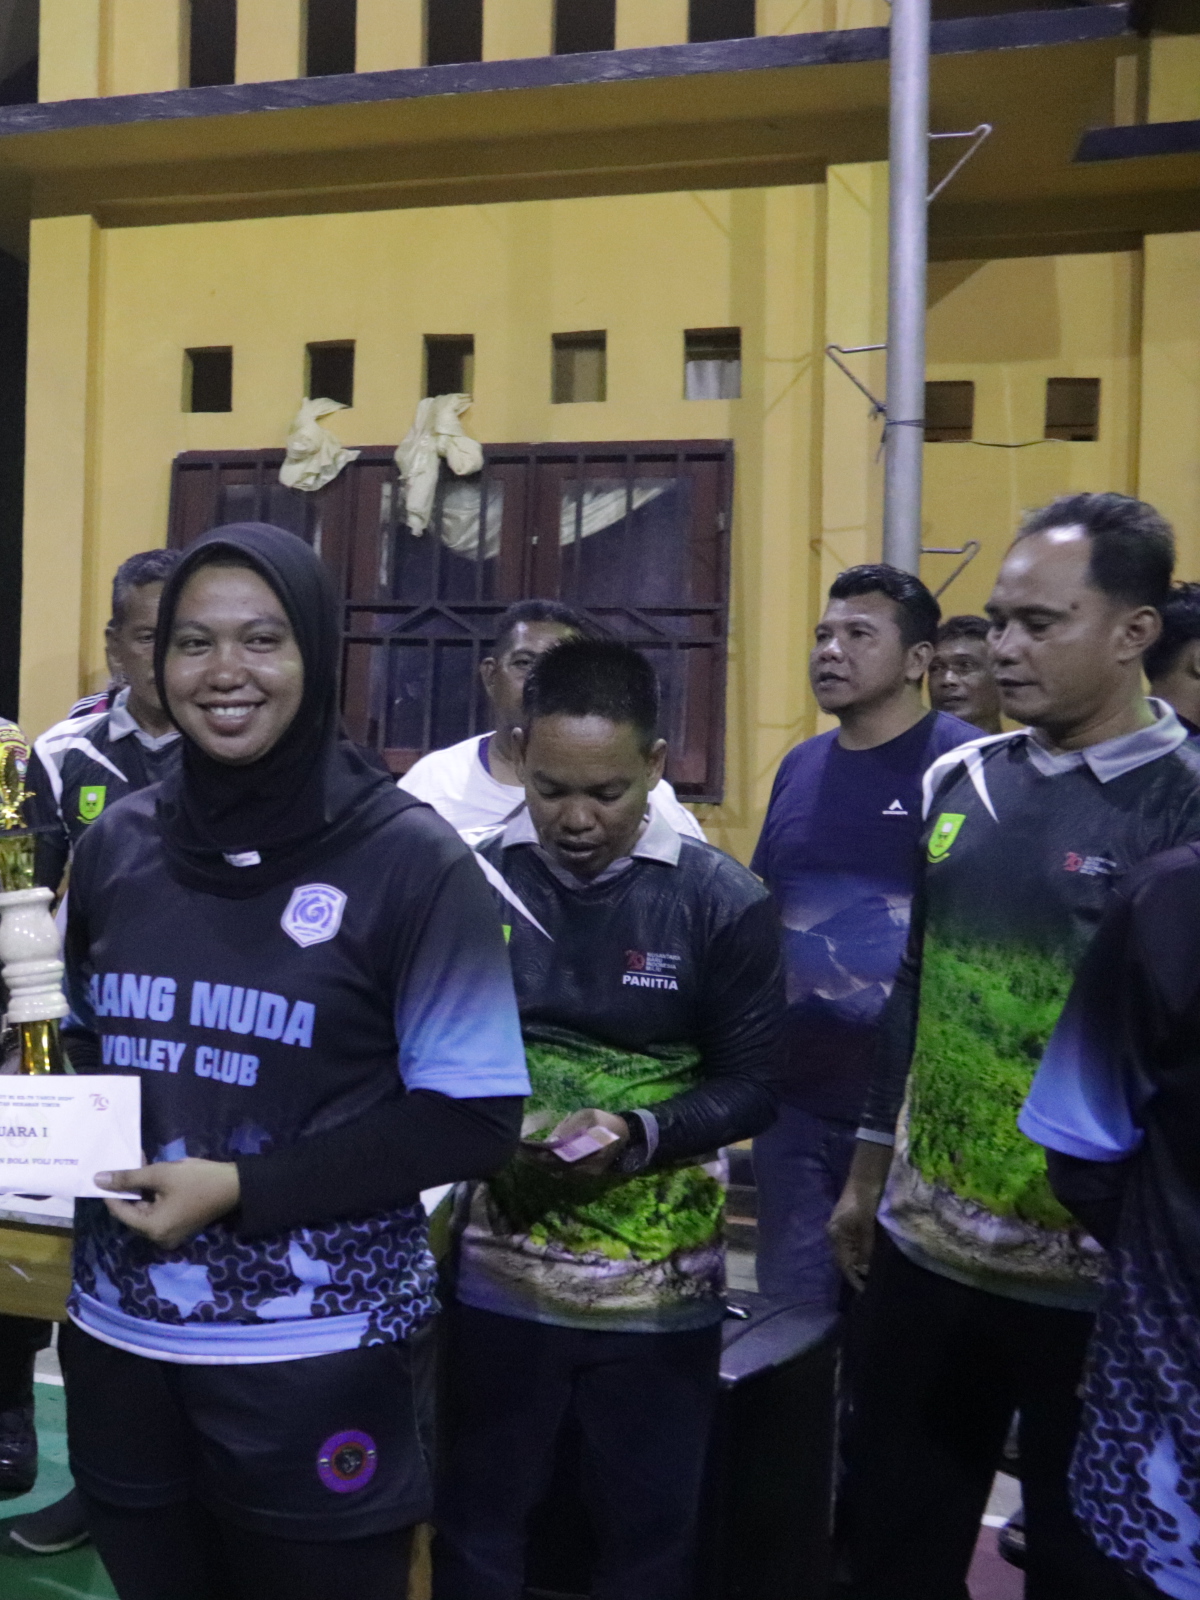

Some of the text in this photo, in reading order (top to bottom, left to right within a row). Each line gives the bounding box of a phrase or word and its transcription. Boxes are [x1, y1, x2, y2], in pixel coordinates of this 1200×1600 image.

[622, 974, 679, 990] PANITIA
[88, 973, 316, 1048] LANG MUDA
[102, 1034, 260, 1087] VOLLEY CLUB
[42, 1127, 49, 1138] I
